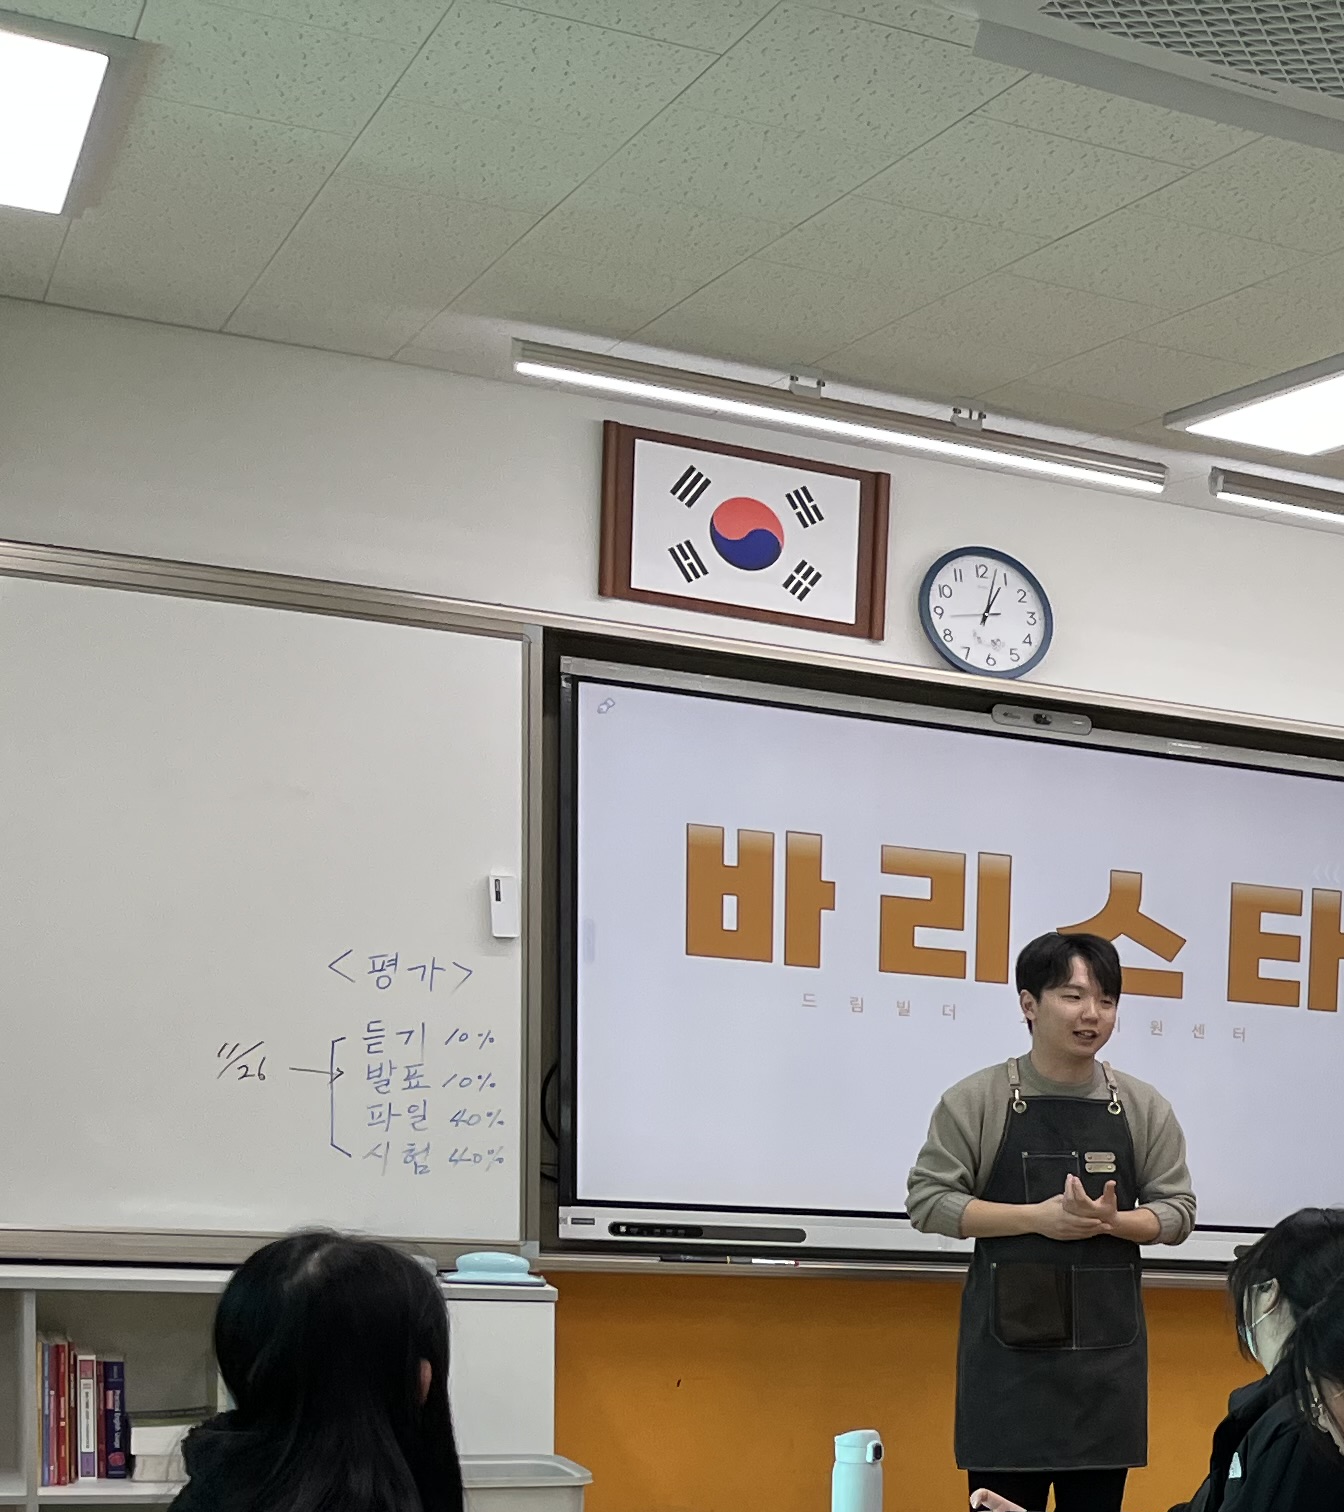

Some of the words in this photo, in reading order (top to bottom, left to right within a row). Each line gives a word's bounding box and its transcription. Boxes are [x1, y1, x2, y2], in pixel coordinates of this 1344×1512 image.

[953, 568, 963, 582] 11
[975, 564, 988, 579] 12
[938, 584, 953, 599] 10
[1016, 588, 1028, 603] 2
[933, 605, 944, 619] 9
[1026, 611, 1037, 626] 3
[942, 628, 953, 642] 8
[1022, 633, 1032, 646] 4
[961, 646, 971, 660] 7
[985, 653, 997, 666] 6
[1009, 648, 1020, 662] 5
[362, 1020, 426, 1062] 듣기
[444, 1027, 495, 1050] 10%
[366, 1059, 431, 1094] 발표
[441, 1072, 497, 1091] 10%
[366, 1099, 431, 1133] 파일
[449, 1108, 505, 1128] 40%
[361, 1140, 431, 1177] 시험
[448, 1145, 505, 1172] 40%
